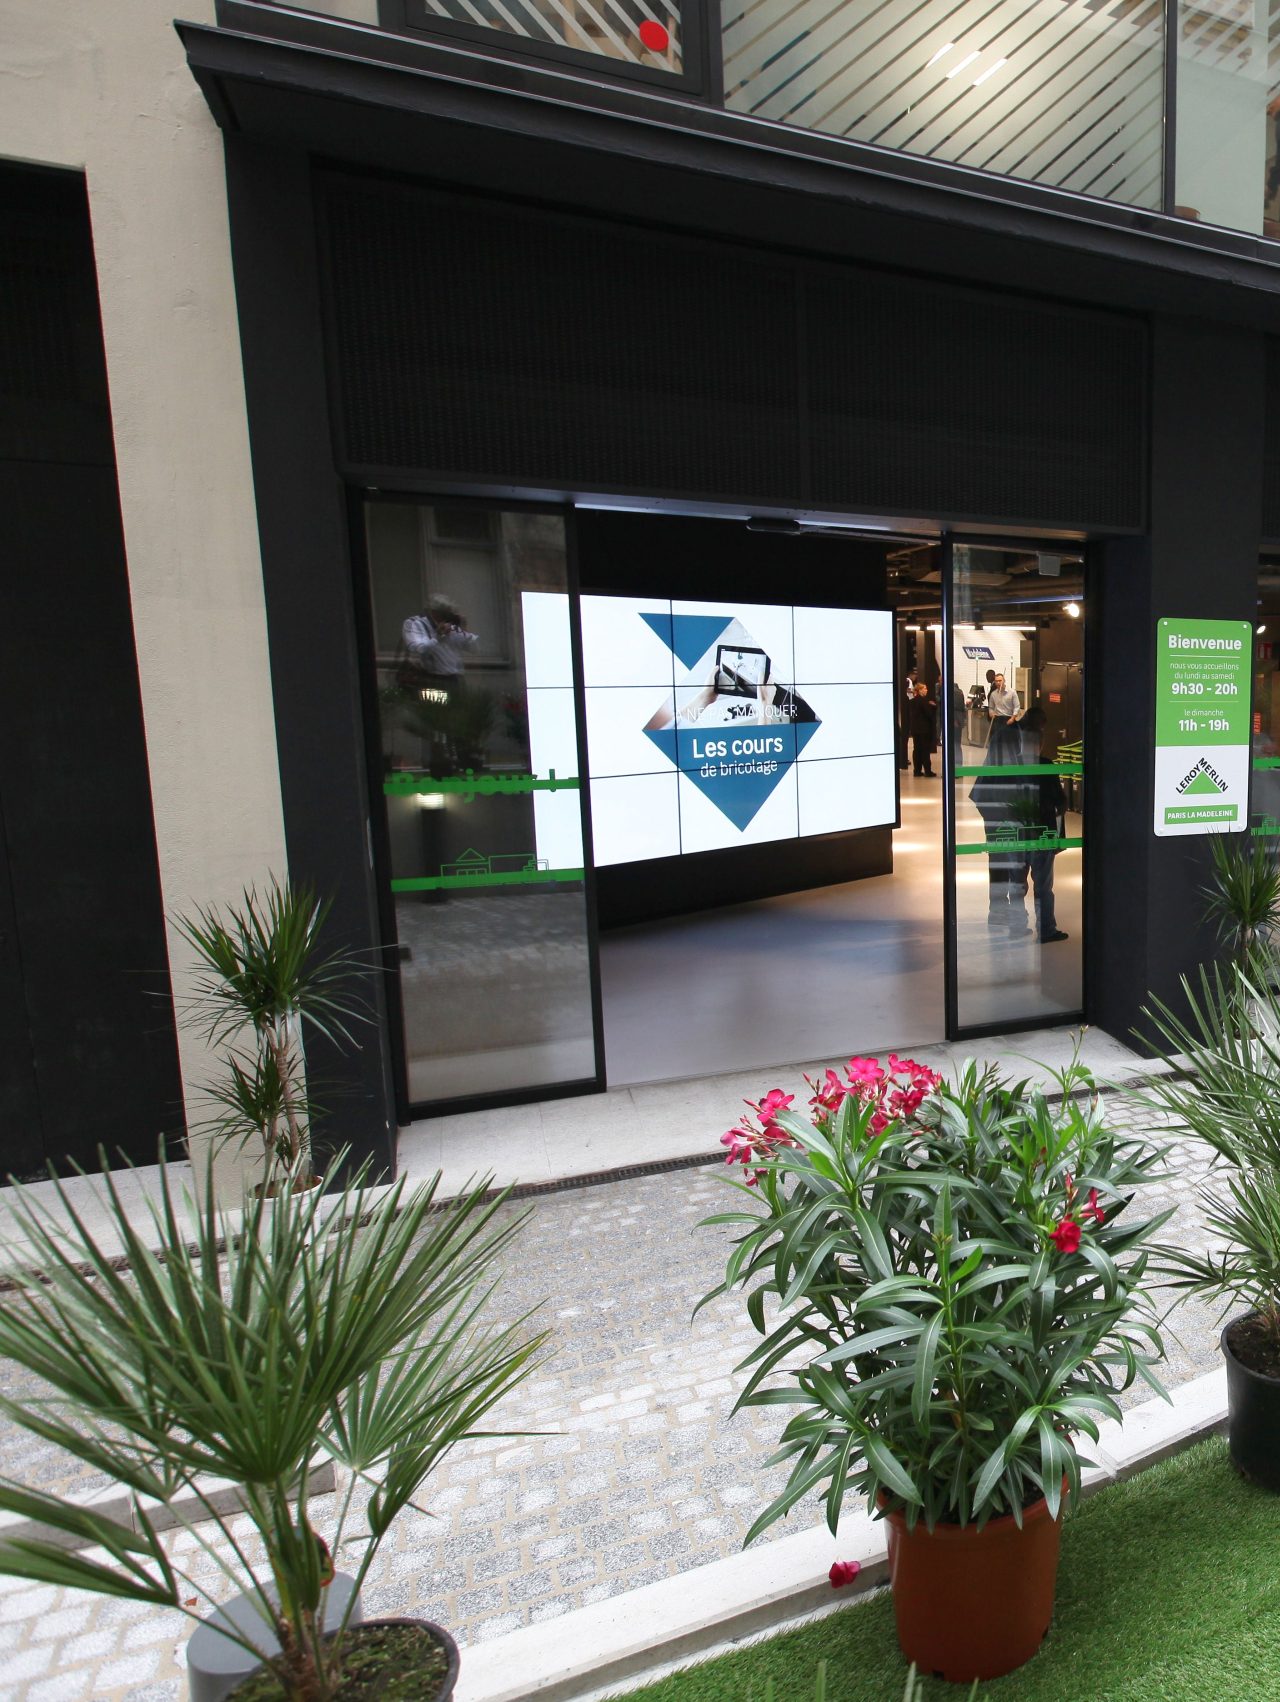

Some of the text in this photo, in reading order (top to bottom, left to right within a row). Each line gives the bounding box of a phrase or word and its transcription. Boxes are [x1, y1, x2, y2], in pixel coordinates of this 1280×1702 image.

[1168, 634, 1242, 650] Bienvenue
[1203, 662, 1239, 670] accueillons
[1174, 672, 1184, 680] du
[1184, 672, 1201, 680] lundi
[1171, 682, 1204, 695] 9h30
[1214, 682, 1238, 695] 20h
[1192, 709, 1224, 717] dimanche
[1178, 718, 1198, 732] 11h
[1208, 718, 1230, 731] 19h
[692, 737, 784, 759] Les cours
[700, 759, 778, 778] de bricolage
[1175, 764, 1201, 794] LEROY
[1198, 757, 1229, 792] MERLIN
[1167, 812, 1186, 820] PARIS
[1196, 810, 1233, 818] MADELEINE
